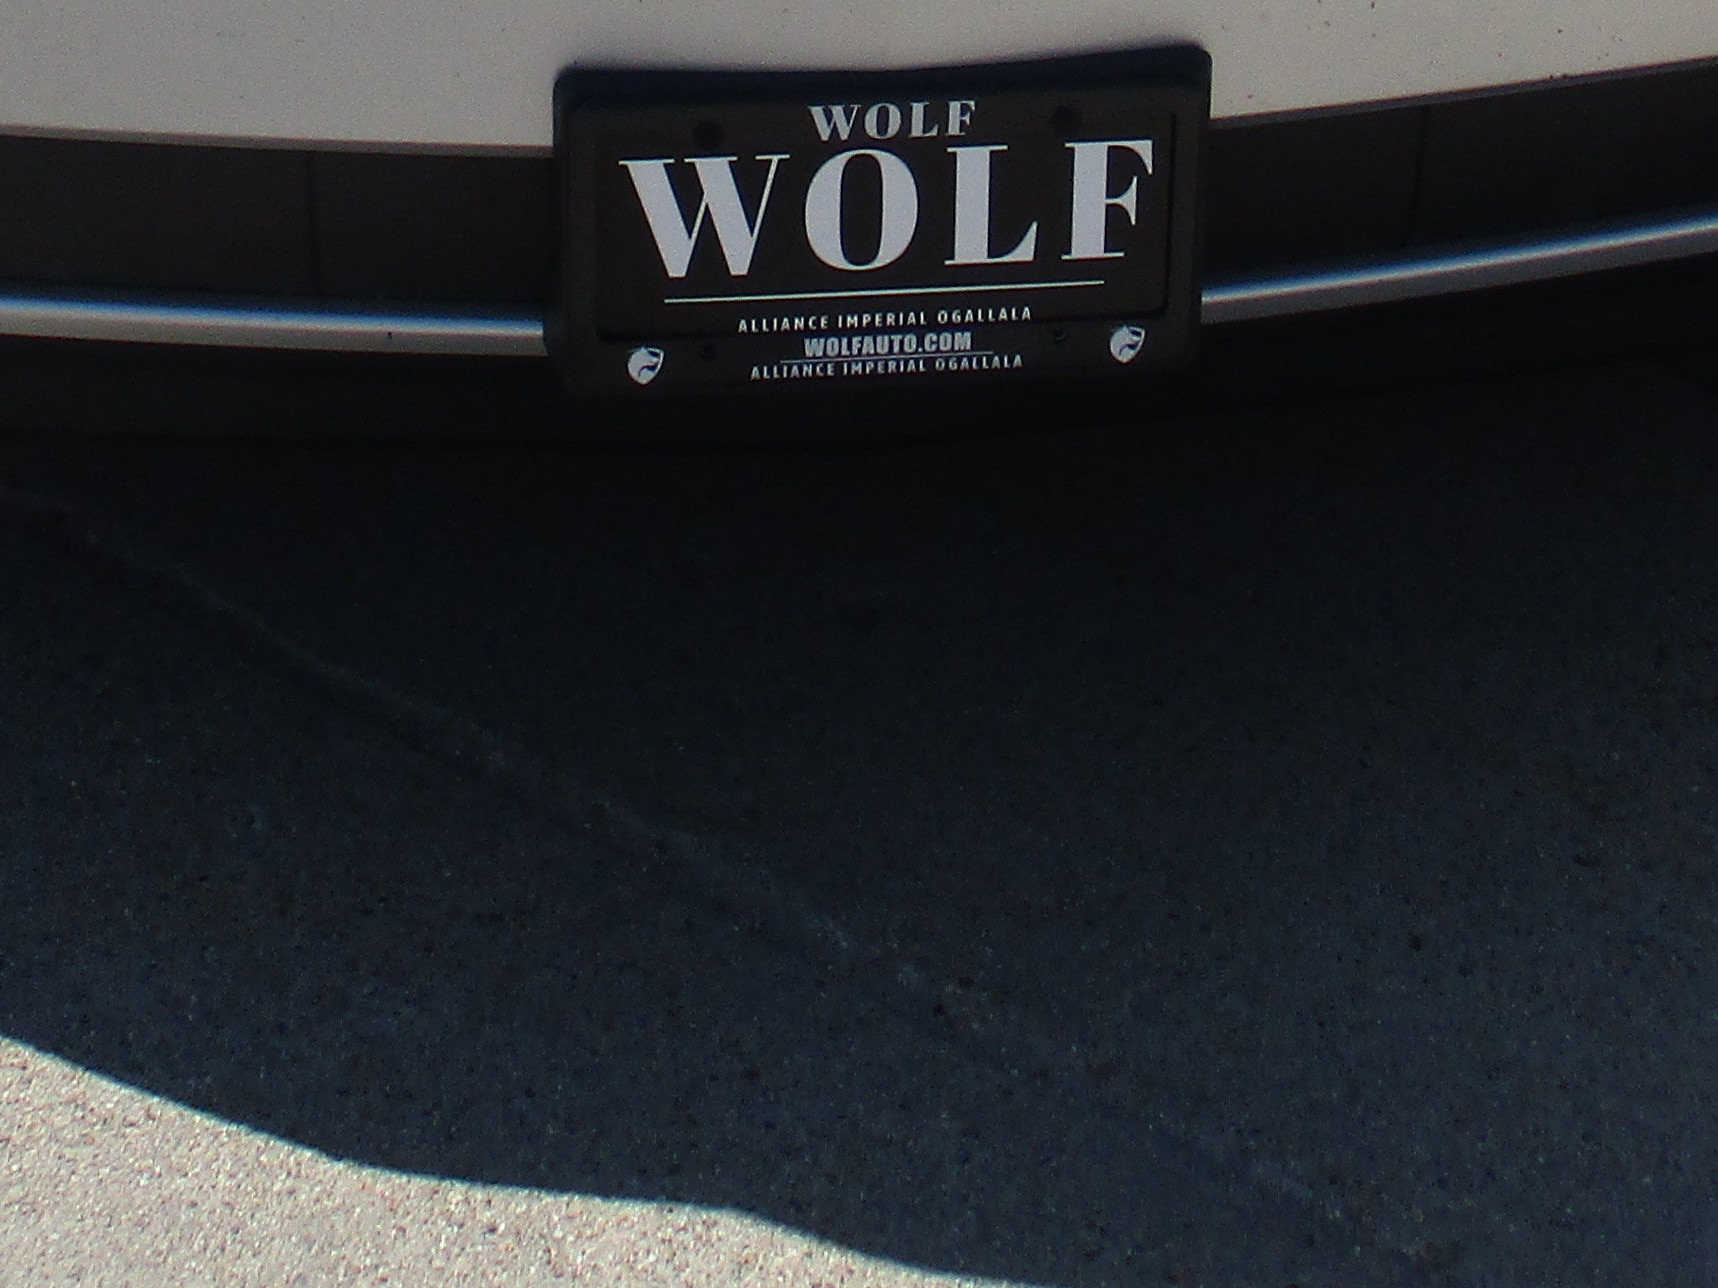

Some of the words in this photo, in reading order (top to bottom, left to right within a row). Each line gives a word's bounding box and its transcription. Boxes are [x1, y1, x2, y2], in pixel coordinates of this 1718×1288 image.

[808, 100, 977, 142] WOLF
[618, 138, 1154, 279] WOLF
[737, 314, 830, 333] ALLIANCE
[837, 310, 928, 329] IMPERIAL
[936, 305, 1032, 324] OGALLALA
[803, 330, 973, 357] WOLFAUTO.COM
[750, 361, 835, 380] ALLIANCE
[842, 357, 928, 375] IMPERIAL
[934, 353, 1023, 372] OGALLALA
